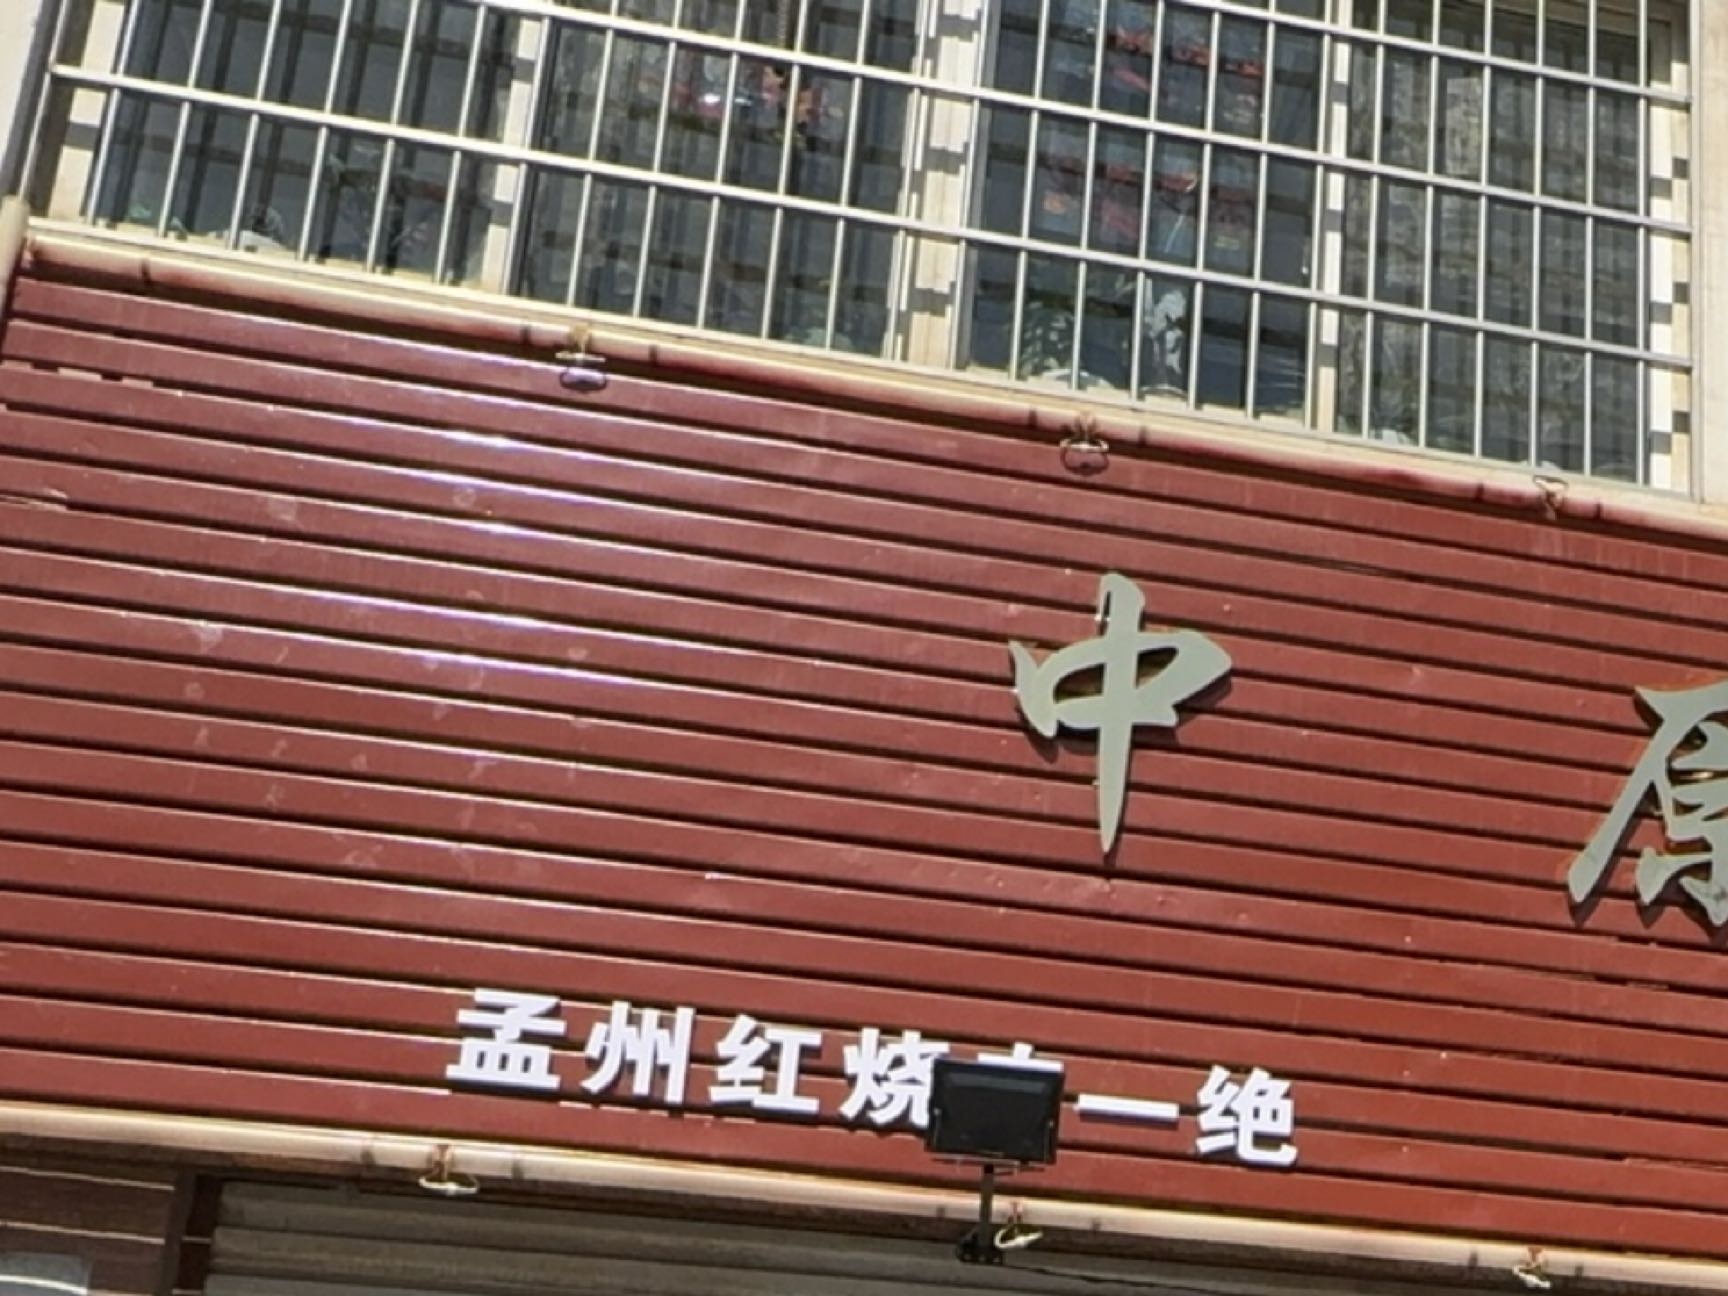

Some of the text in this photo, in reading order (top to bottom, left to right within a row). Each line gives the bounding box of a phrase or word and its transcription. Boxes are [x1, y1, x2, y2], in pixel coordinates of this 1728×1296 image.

[445, 986, 1300, 1168] 孟州红烧一绝
